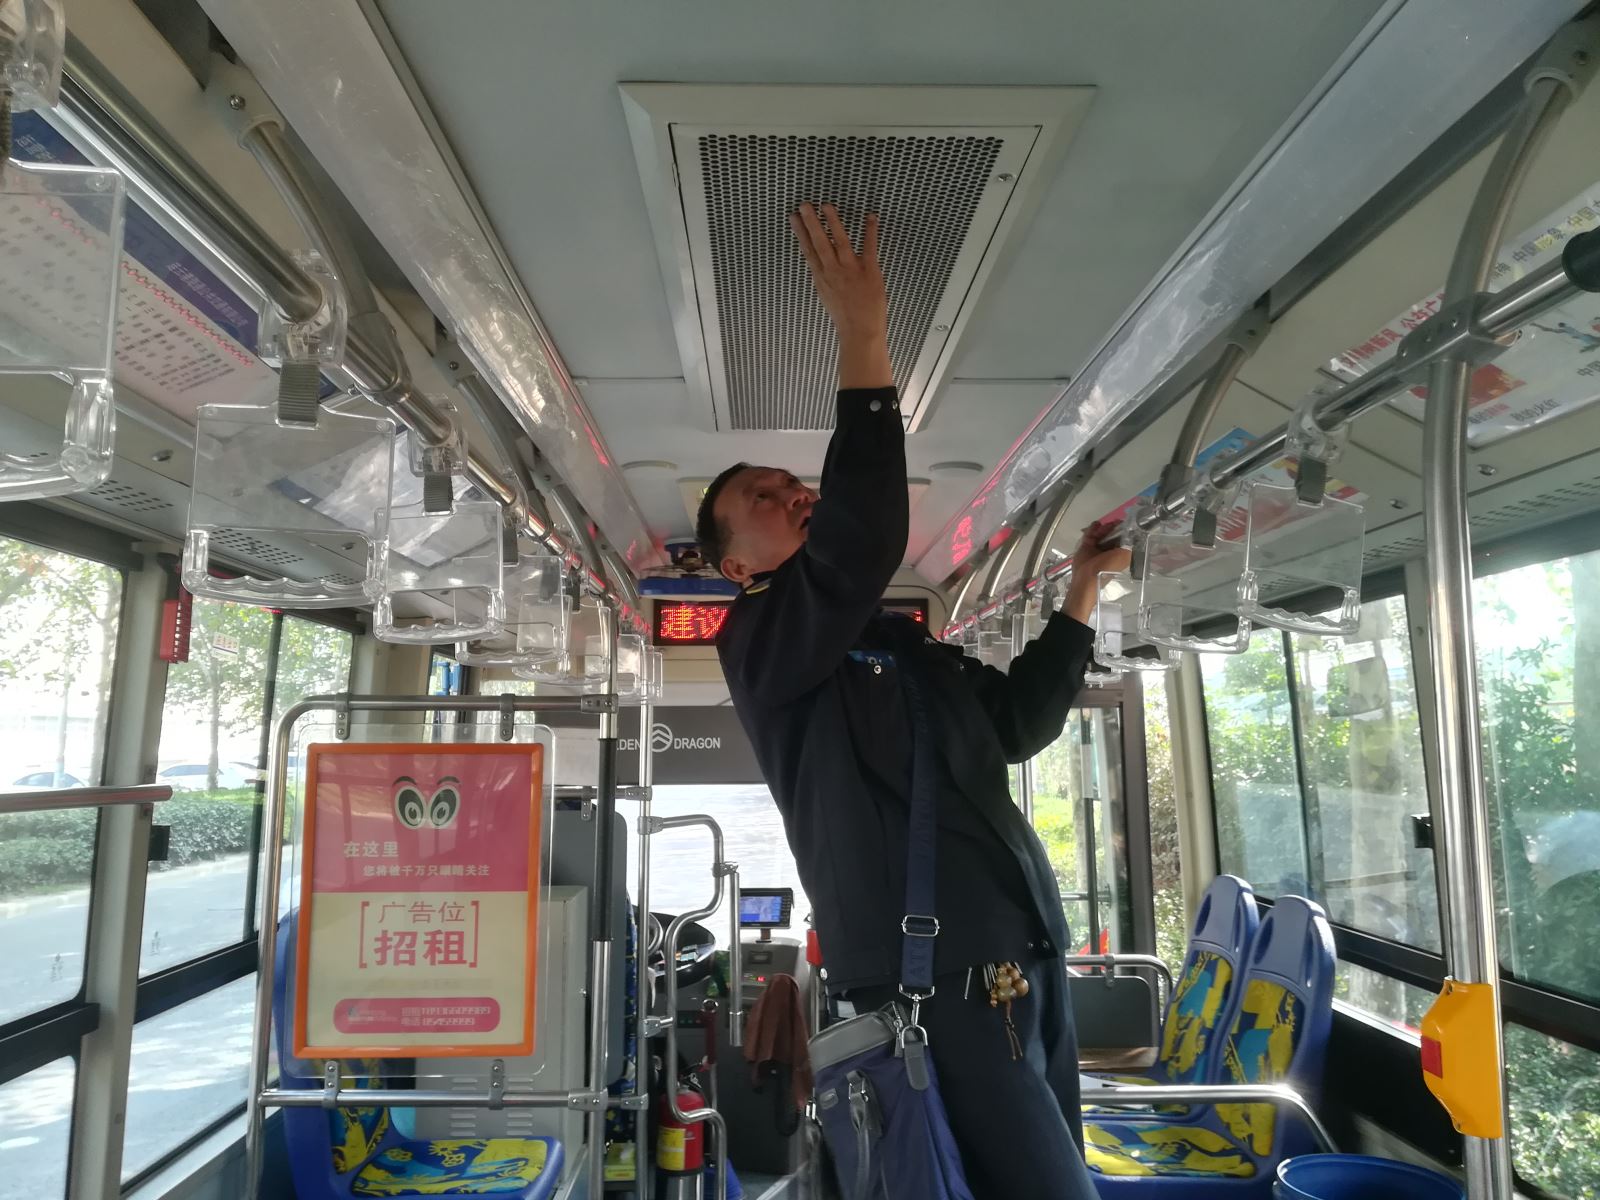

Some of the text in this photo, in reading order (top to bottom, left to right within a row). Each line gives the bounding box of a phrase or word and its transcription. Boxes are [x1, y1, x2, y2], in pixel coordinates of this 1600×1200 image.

[616, 737, 721, 751] DEN DRAGON
[344, 841, 399, 858] 在这里
[378, 901, 465, 924] 广告位
[373, 929, 467, 967] 招租
